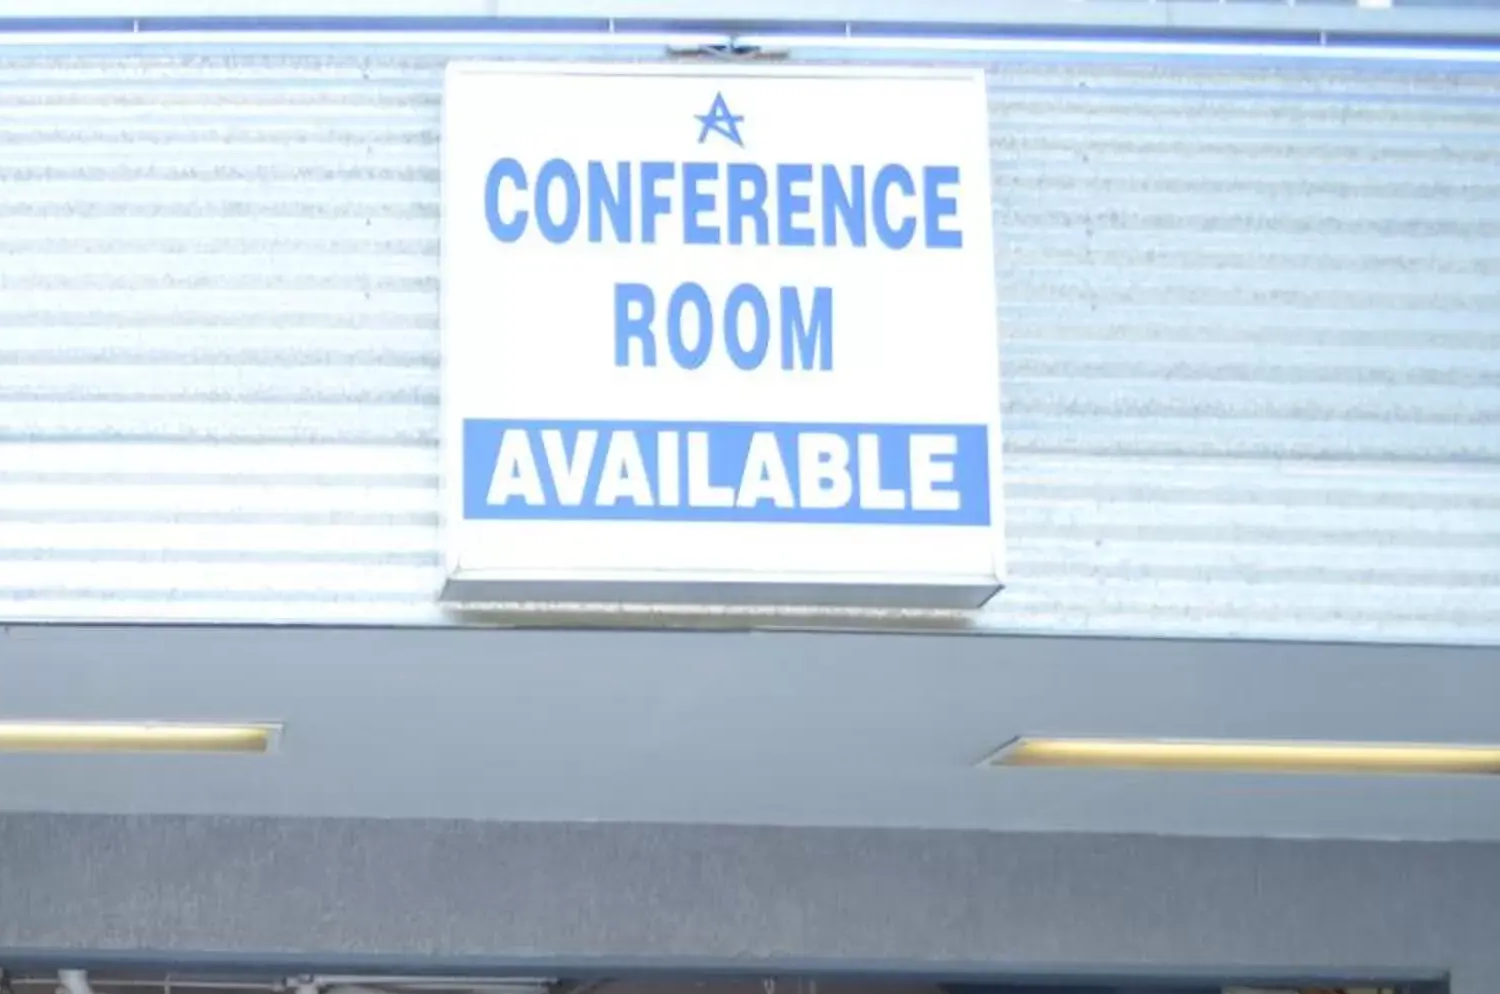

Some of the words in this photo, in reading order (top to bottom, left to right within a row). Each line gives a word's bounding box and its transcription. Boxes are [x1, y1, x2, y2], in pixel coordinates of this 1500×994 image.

[484, 157, 964, 250] CONFERENCE
[613, 281, 835, 371] ROOM
[486, 428, 961, 511] AVAILABLE
